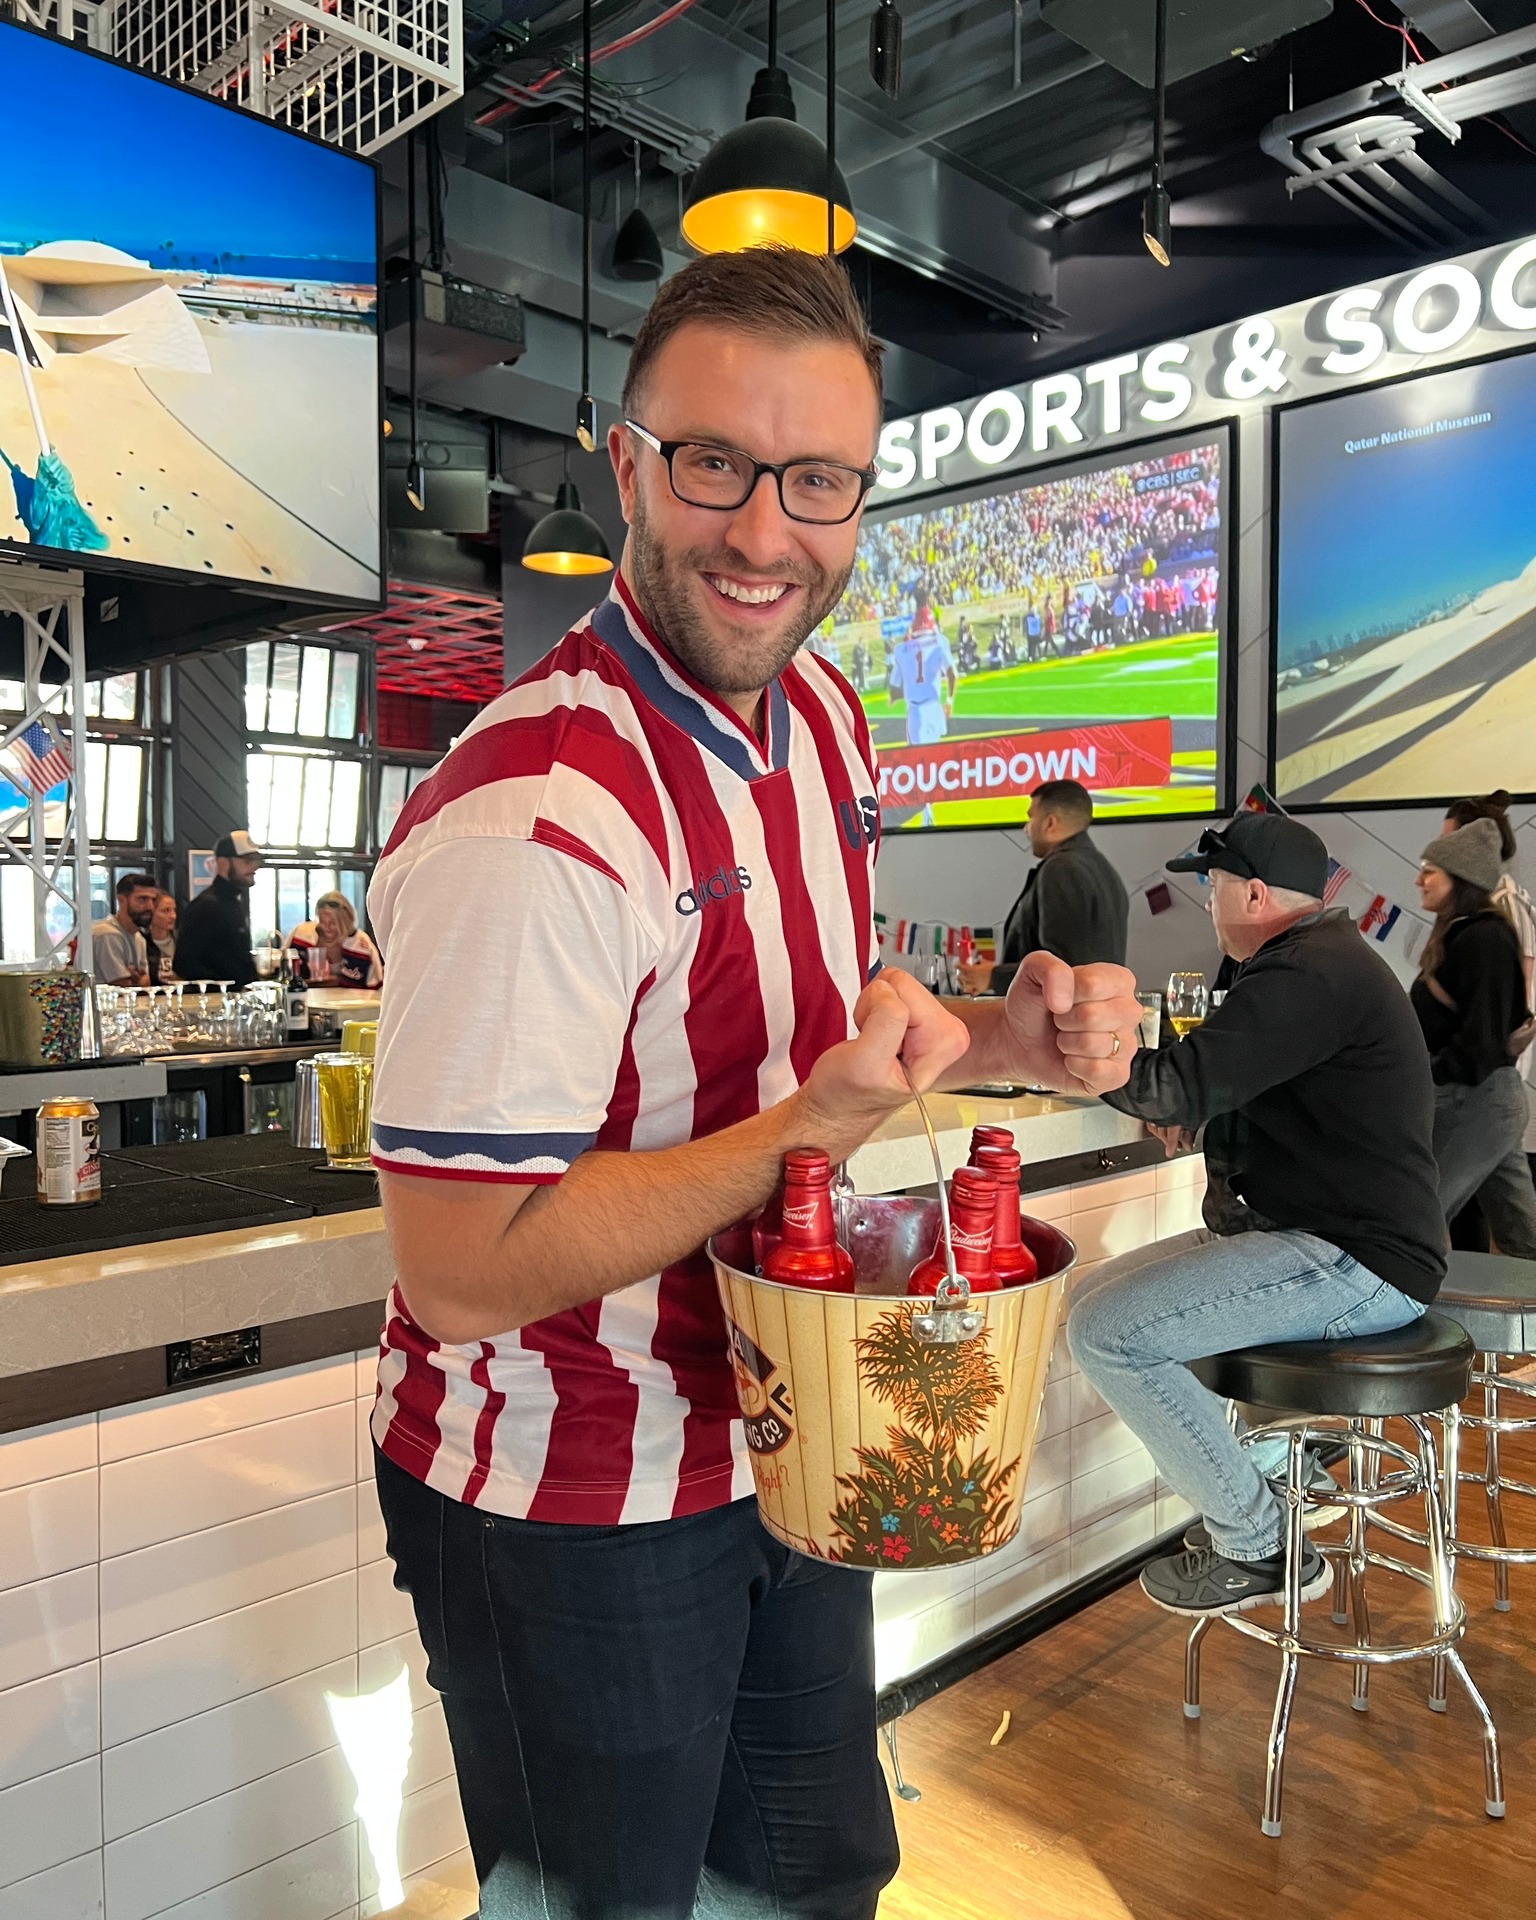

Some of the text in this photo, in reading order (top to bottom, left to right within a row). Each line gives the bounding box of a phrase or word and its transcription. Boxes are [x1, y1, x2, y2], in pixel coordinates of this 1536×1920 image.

[876, 342, 1192, 489] SPORTS
[1223, 317, 1288, 400] &
[1344, 411, 1492, 454] Qatar National Museum
[1175, 467, 1200, 484] SEC
[881, 745, 1096, 795] TOUCHDOWN
